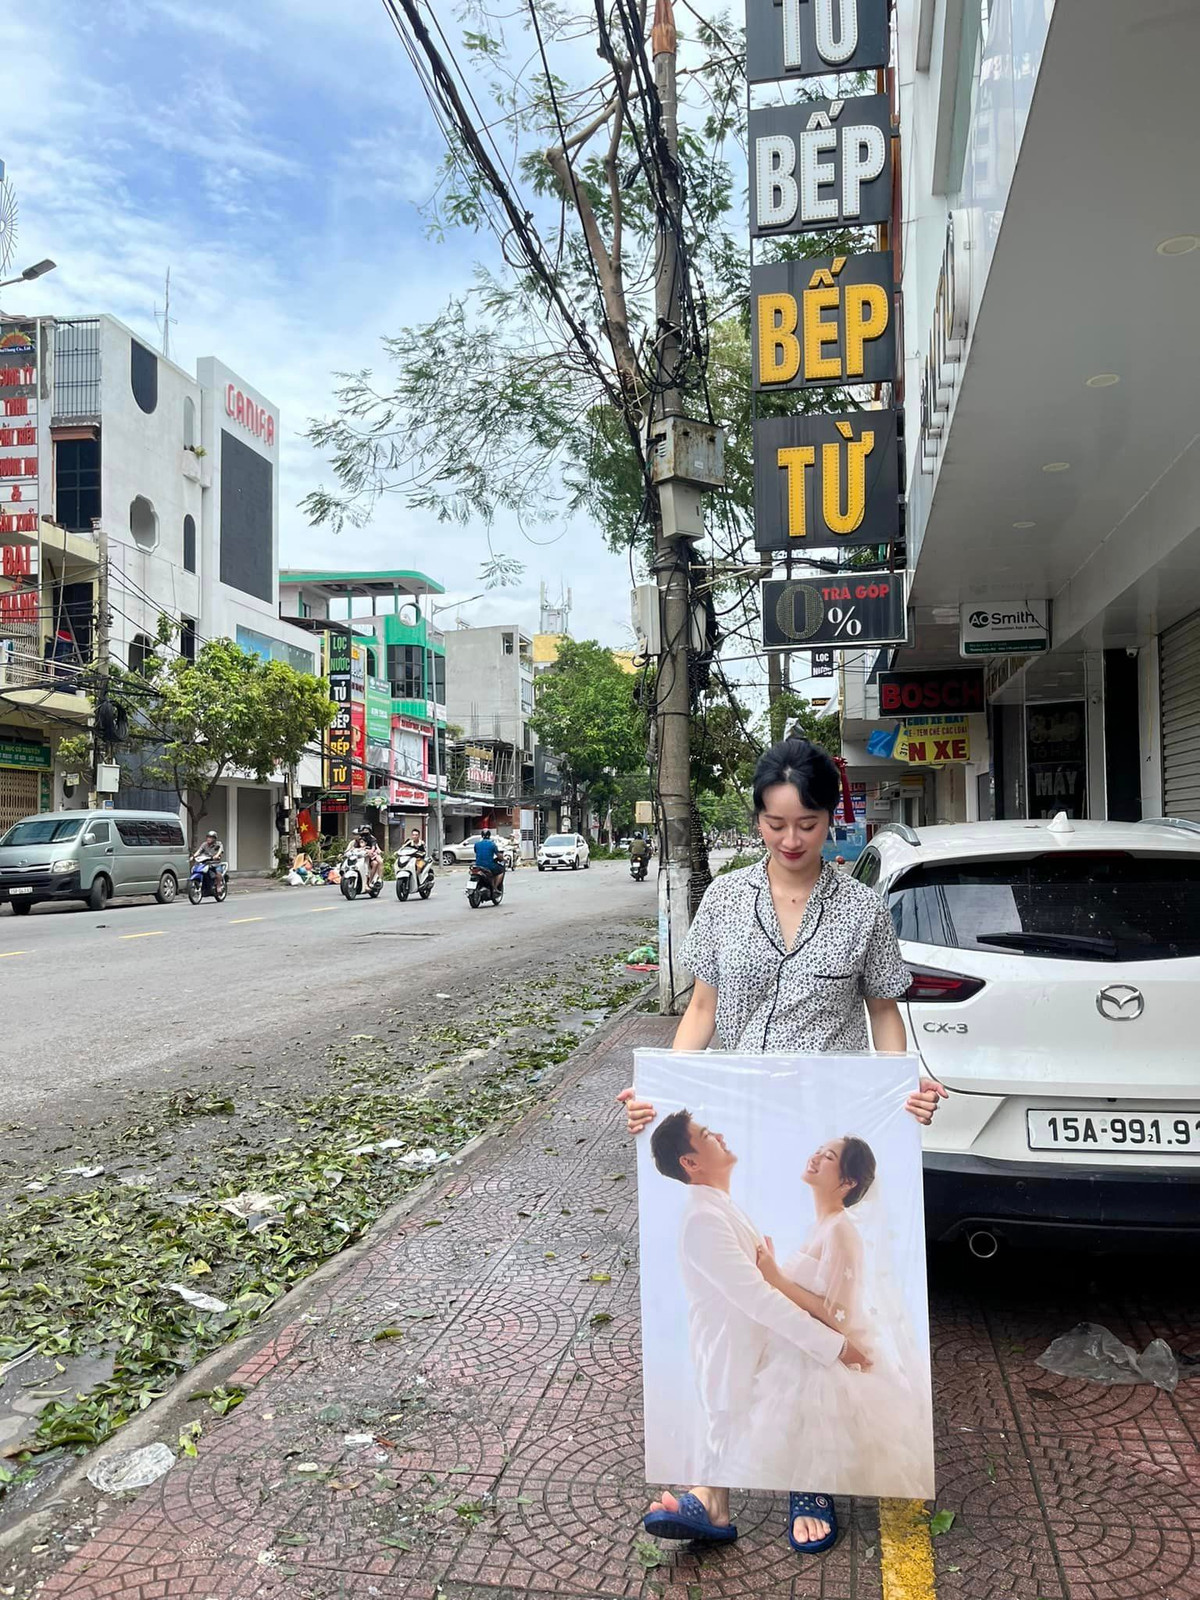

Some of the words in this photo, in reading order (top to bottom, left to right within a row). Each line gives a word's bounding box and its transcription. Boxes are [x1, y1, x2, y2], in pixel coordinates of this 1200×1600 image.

[755, 100, 886, 229] BẾP
[758, 256, 889, 385] BẾP
[225, 383, 275, 447] CANIFA
[777, 421, 875, 538] TỪ
[11, 484, 22, 502] &
[776, 585, 862, 640] 0%
[991, 610, 1035, 625] Smith
[333, 636, 347, 652] LỌC
[330, 653, 350, 671] NƯỚC
[333, 681, 347, 701] TỦ
[881, 680, 982, 710] BOSCH
[933, 739, 967, 760] XE
[333, 765, 347, 782] TỪ
[1035, 766, 1078, 796] MÁY
[923, 1022, 968, 1034] CX-3
[1048, 1116, 1200, 1144] 15A-991.9
